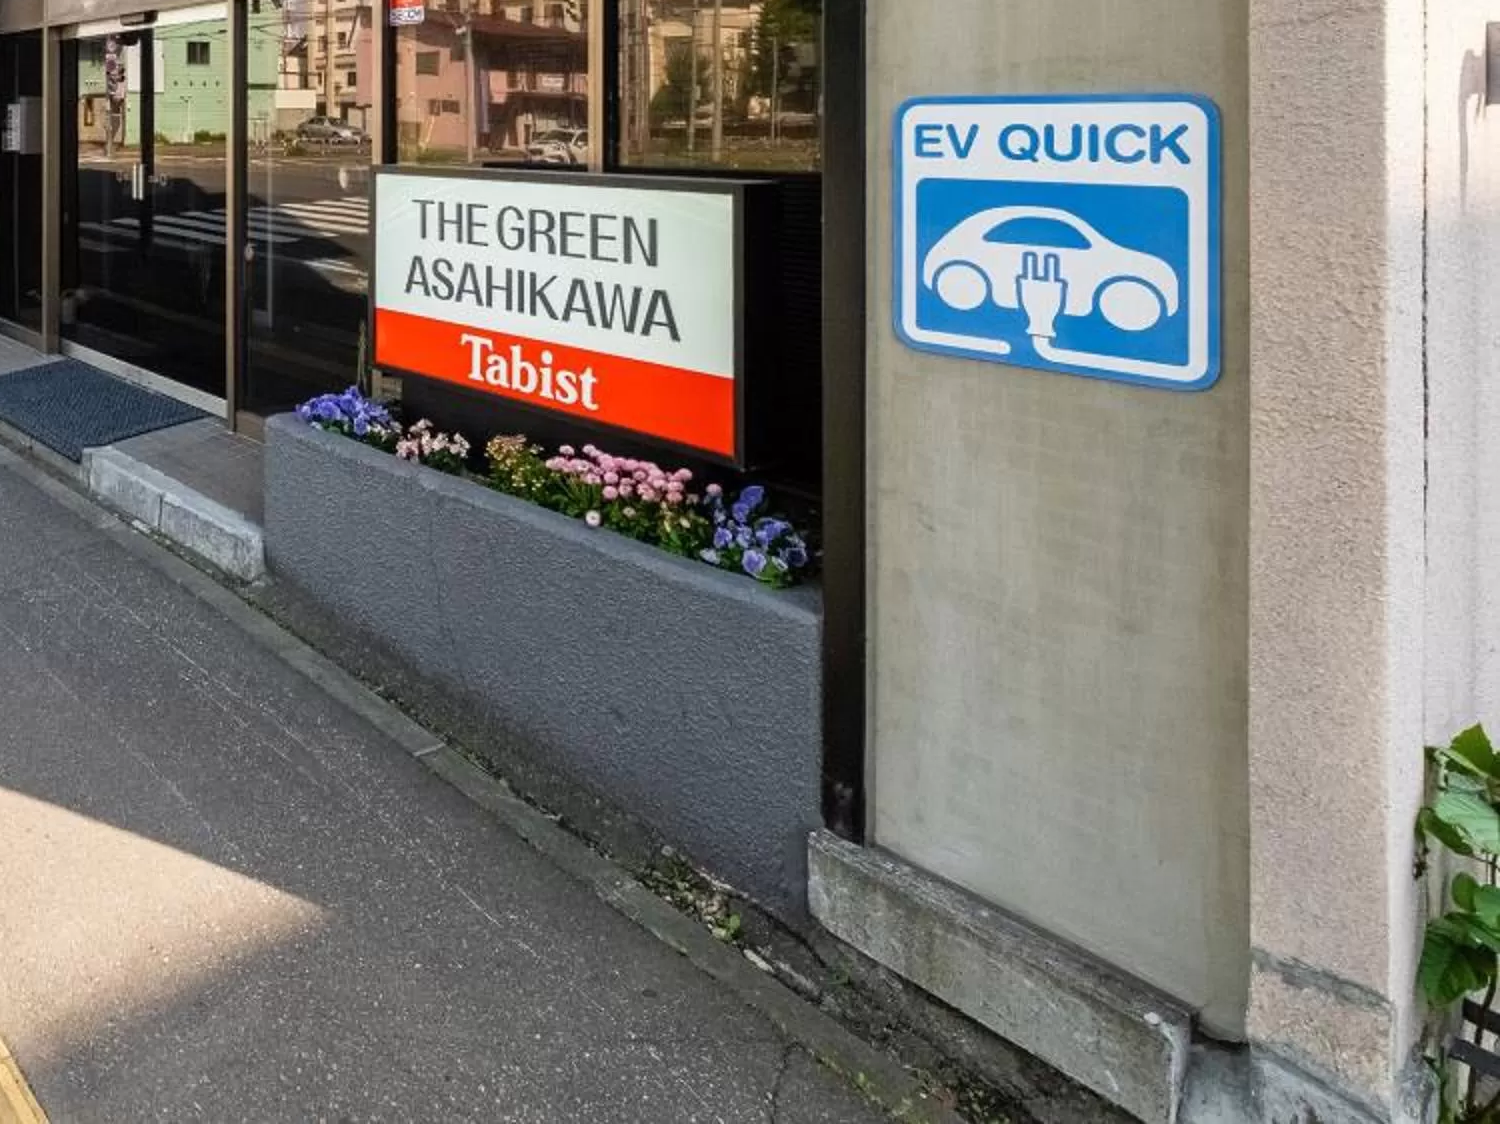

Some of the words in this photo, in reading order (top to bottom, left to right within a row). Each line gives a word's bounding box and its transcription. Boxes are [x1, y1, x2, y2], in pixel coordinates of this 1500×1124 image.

[913, 123, 980, 160] EV
[997, 122, 1191, 165] QUICK
[411, 198, 489, 247] THE
[496, 205, 659, 267] GREEN
[404, 255, 681, 343] ASAHIKAWA
[460, 333, 599, 411] Tabist
